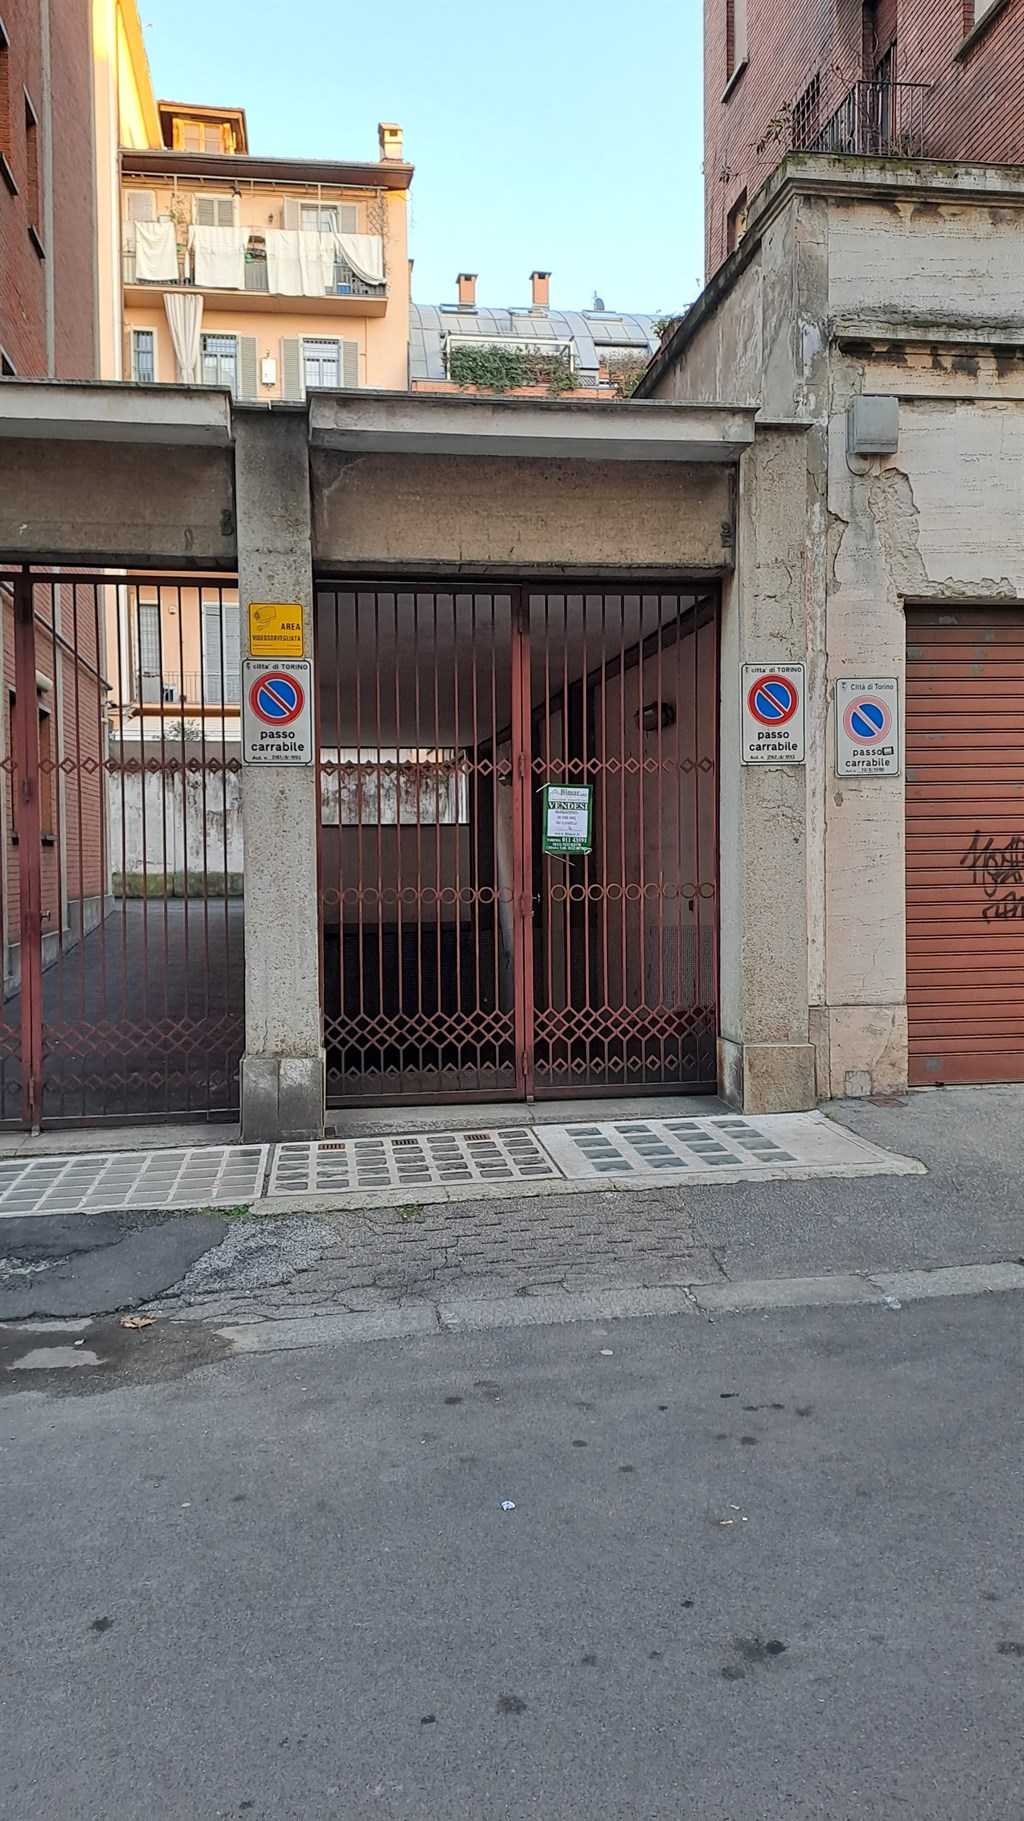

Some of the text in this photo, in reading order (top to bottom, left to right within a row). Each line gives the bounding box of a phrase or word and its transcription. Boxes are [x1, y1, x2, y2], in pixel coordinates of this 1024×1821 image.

[281, 623, 301, 631] AREA
[260, 730, 295, 740] passo
[757, 730, 790, 740] passo
[251, 741, 305, 752] carrabile
[749, 741, 798, 752] carrabile
[852, 748, 883, 757] passo
[845, 758, 891, 767] carrabile
[548, 801, 588, 810] VENDESI
